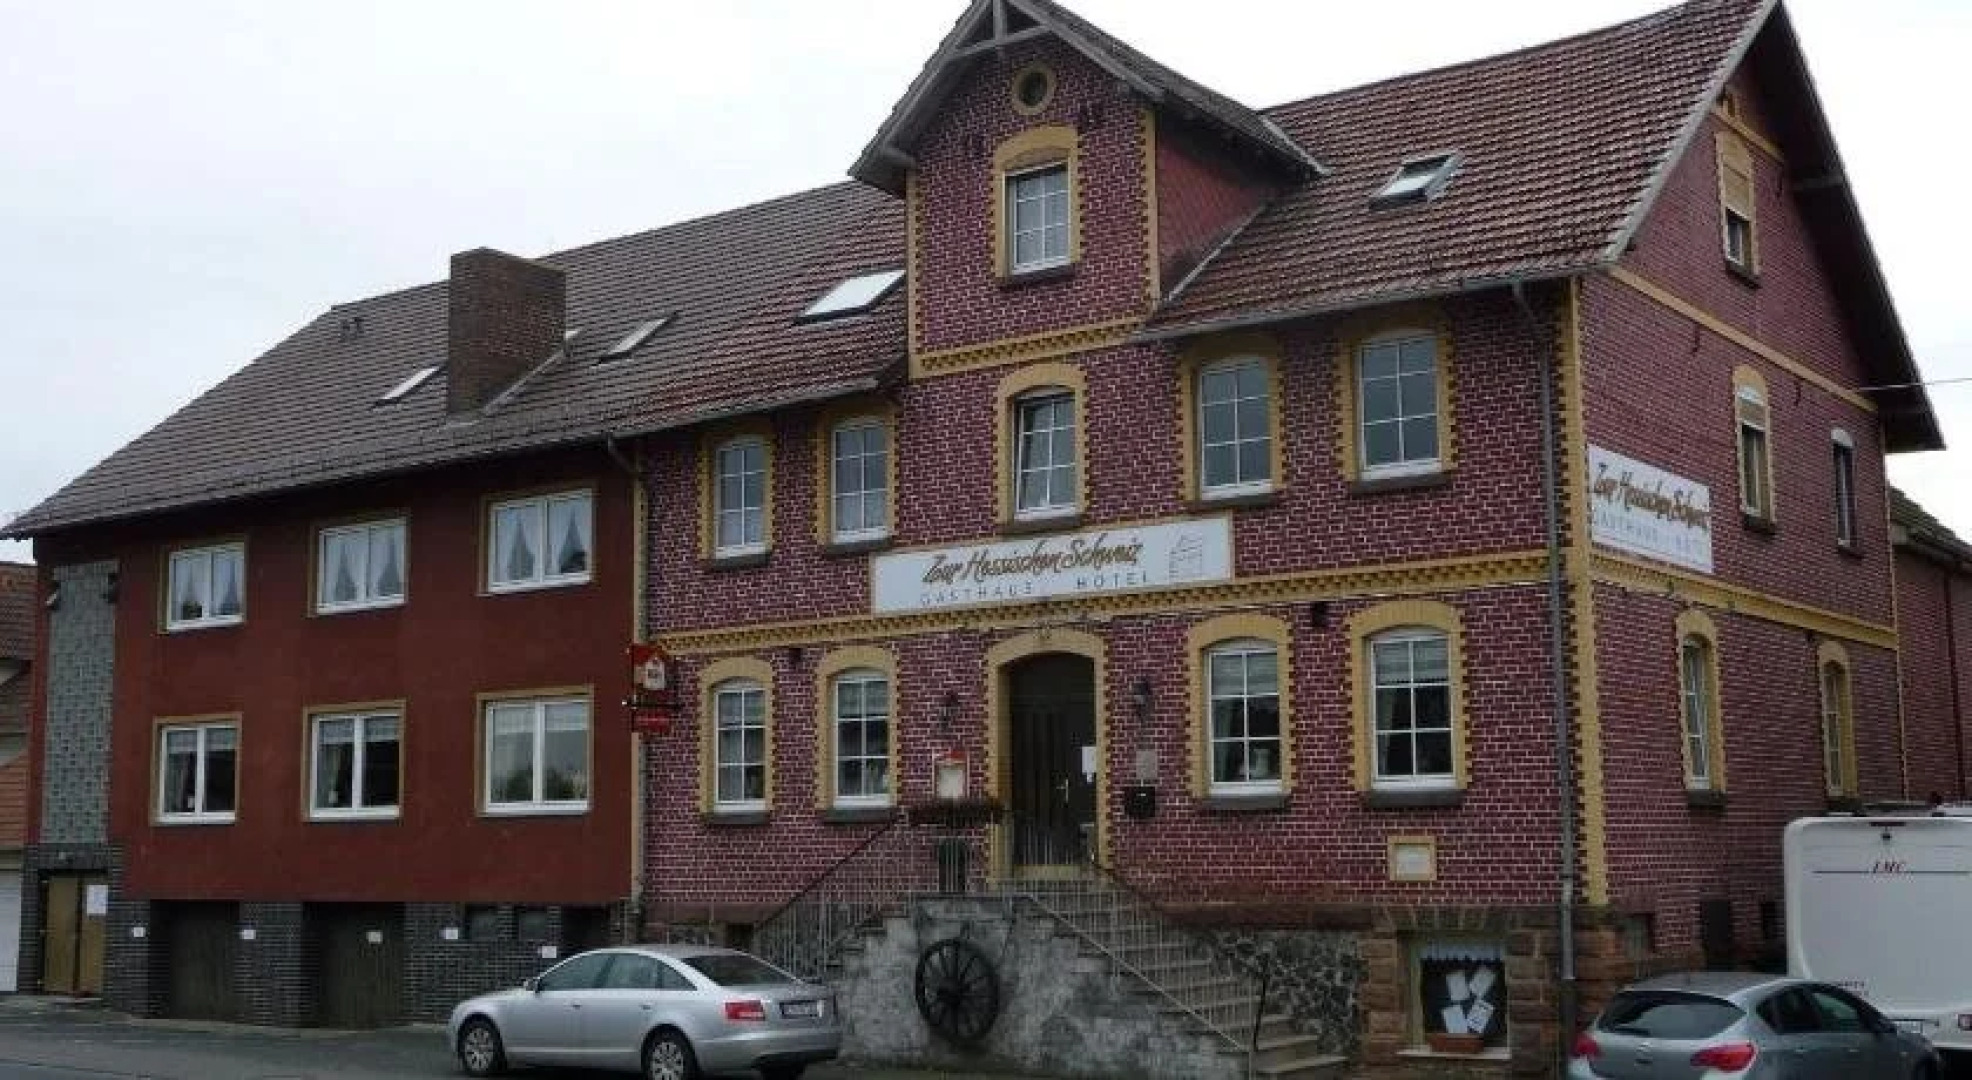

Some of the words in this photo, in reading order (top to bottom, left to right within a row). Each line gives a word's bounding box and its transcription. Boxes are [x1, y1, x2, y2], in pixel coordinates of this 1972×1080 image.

[922, 553, 962, 584] Zur
[962, 539, 1061, 582] Hessischen
[920, 581, 1032, 605] GASTHAUS
[1077, 570, 1147, 589] HOTEL
